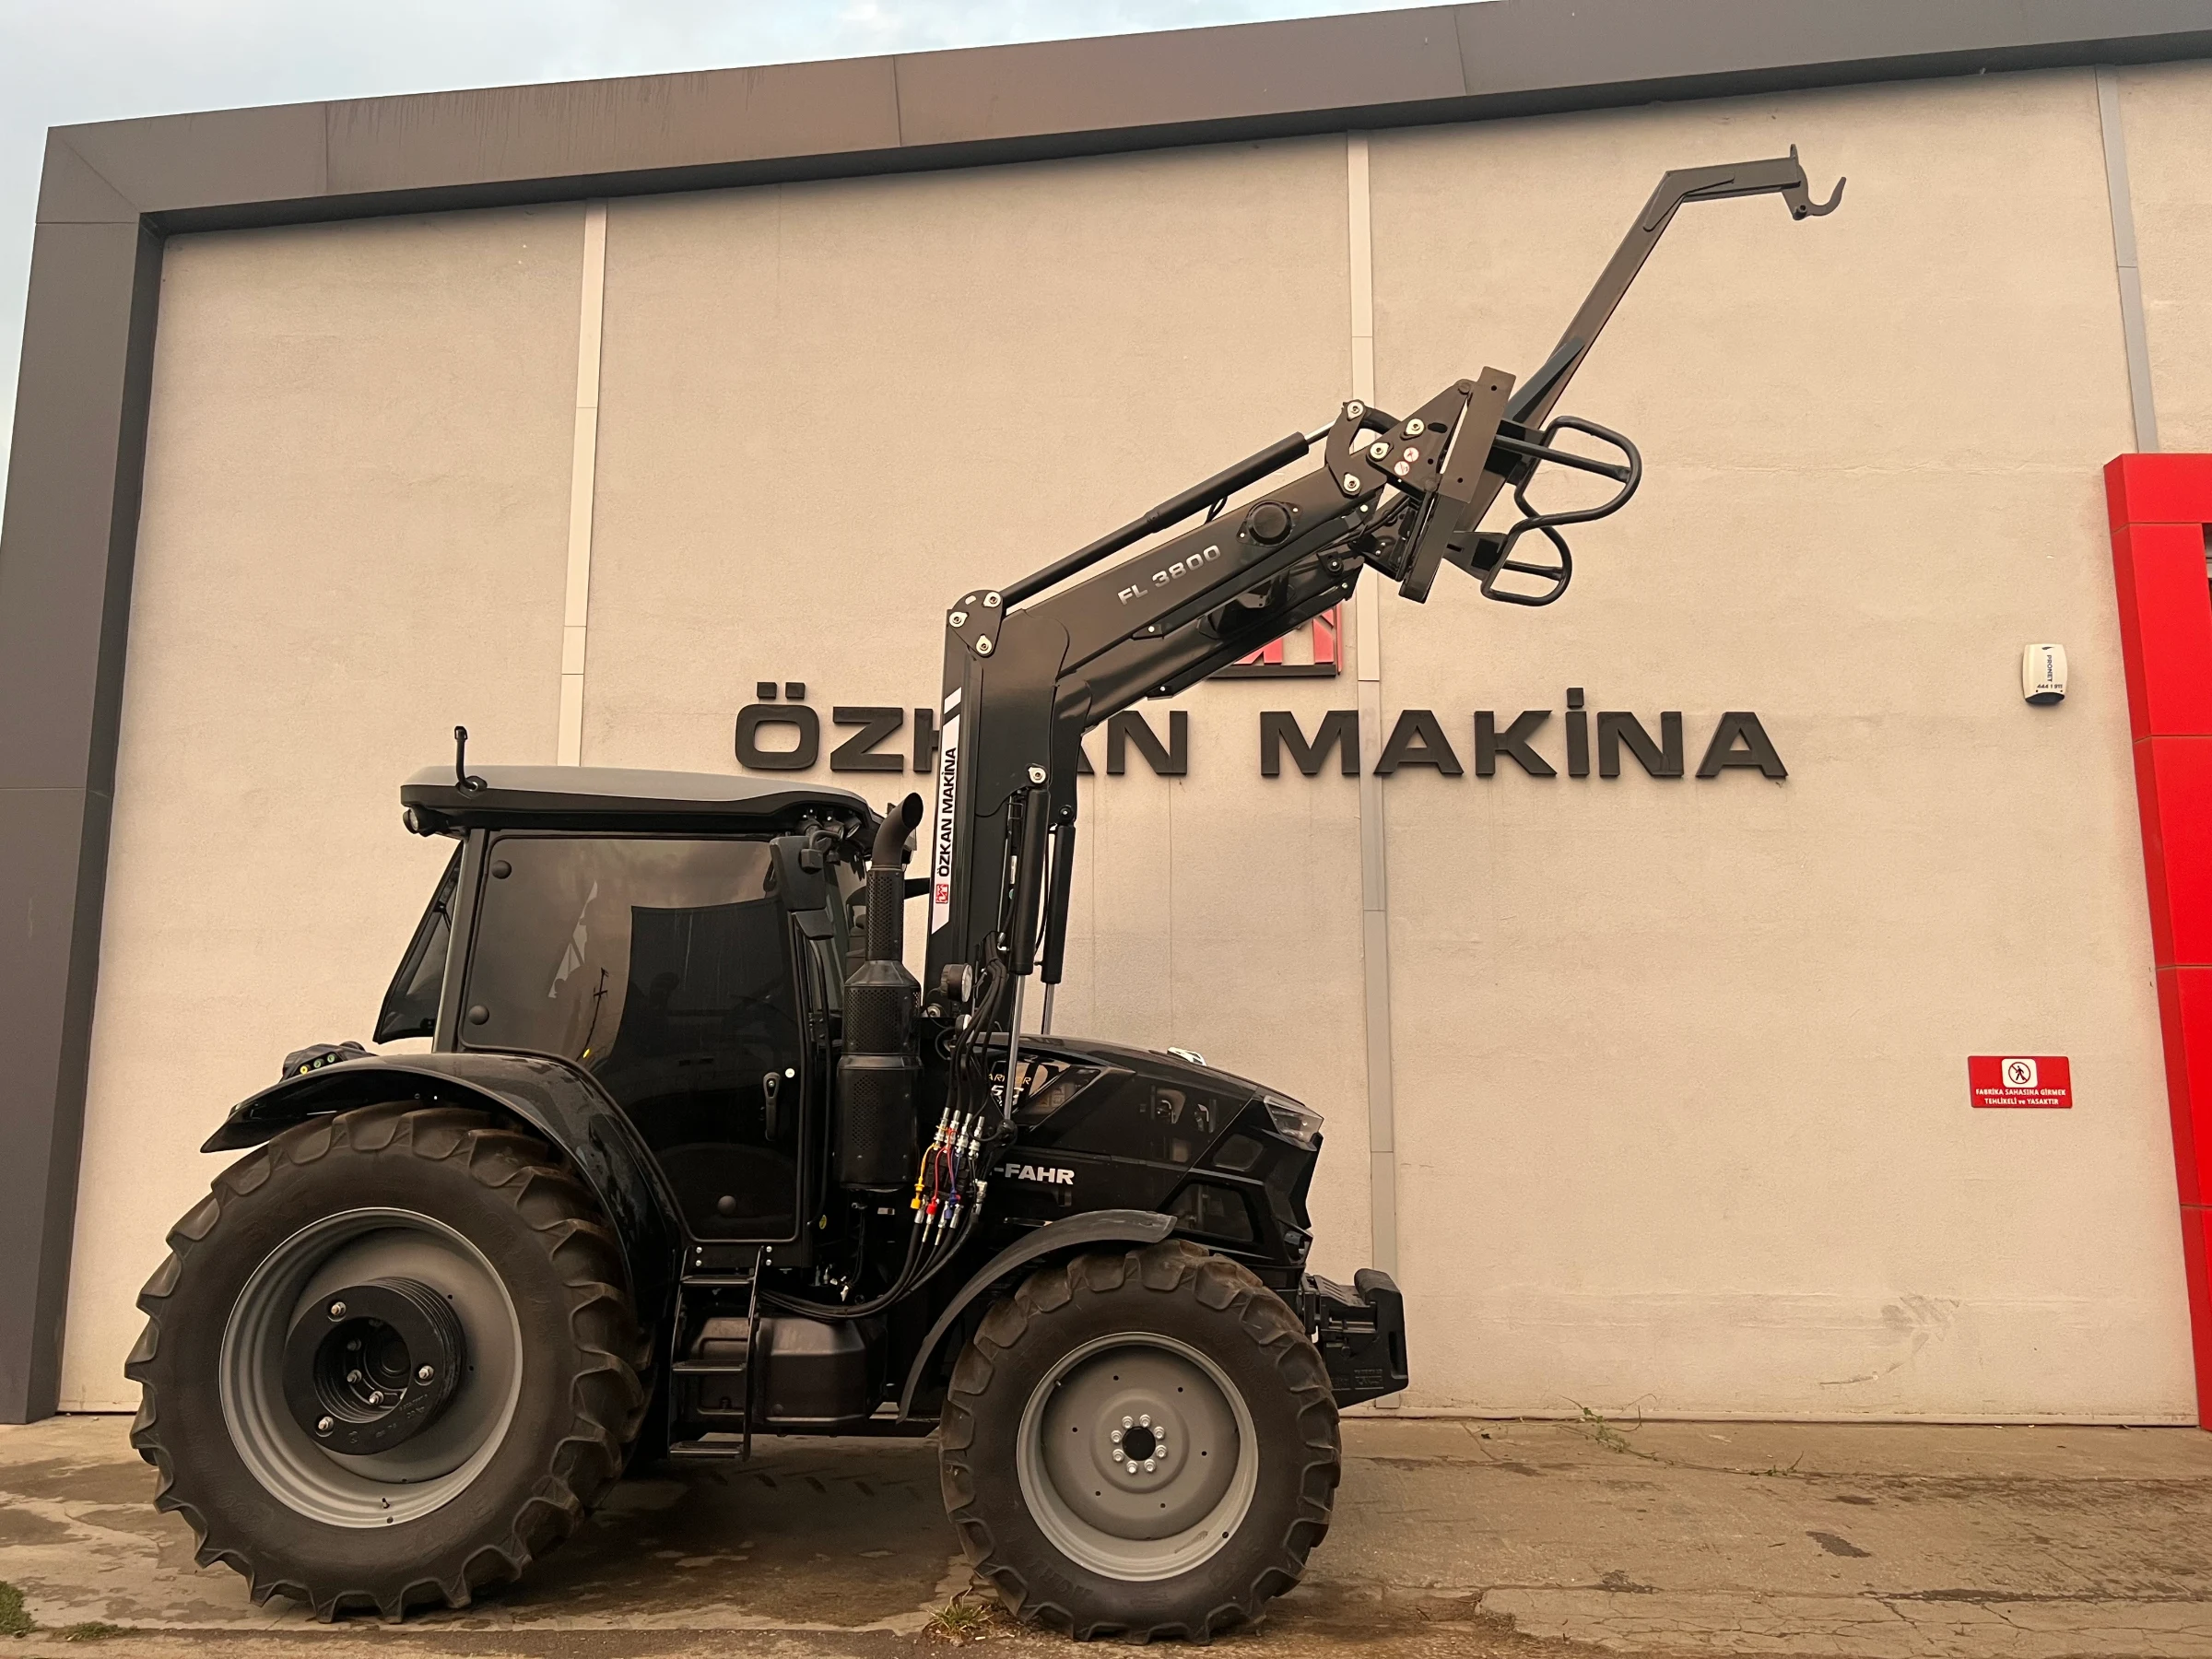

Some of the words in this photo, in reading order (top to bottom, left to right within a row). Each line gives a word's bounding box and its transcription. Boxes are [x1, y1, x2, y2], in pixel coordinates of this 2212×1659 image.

[1117, 583, 1148, 606] FL
[1152, 545, 1221, 588] 3800
[735, 681, 1188, 776] ÖZN
[1259, 687, 1789, 778] MAKİNA
[940, 747, 957, 814] MAKİNA
[936, 818, 953, 877] ÖZKAN
[1975, 1088, 2004, 1096] FABRİKA
[2040, 1088, 2066, 1096] GİRMEK
[1983, 1097, 2018, 1105] TEHLİKELİ
[991, 1163, 1076, 1185] -FAHR
